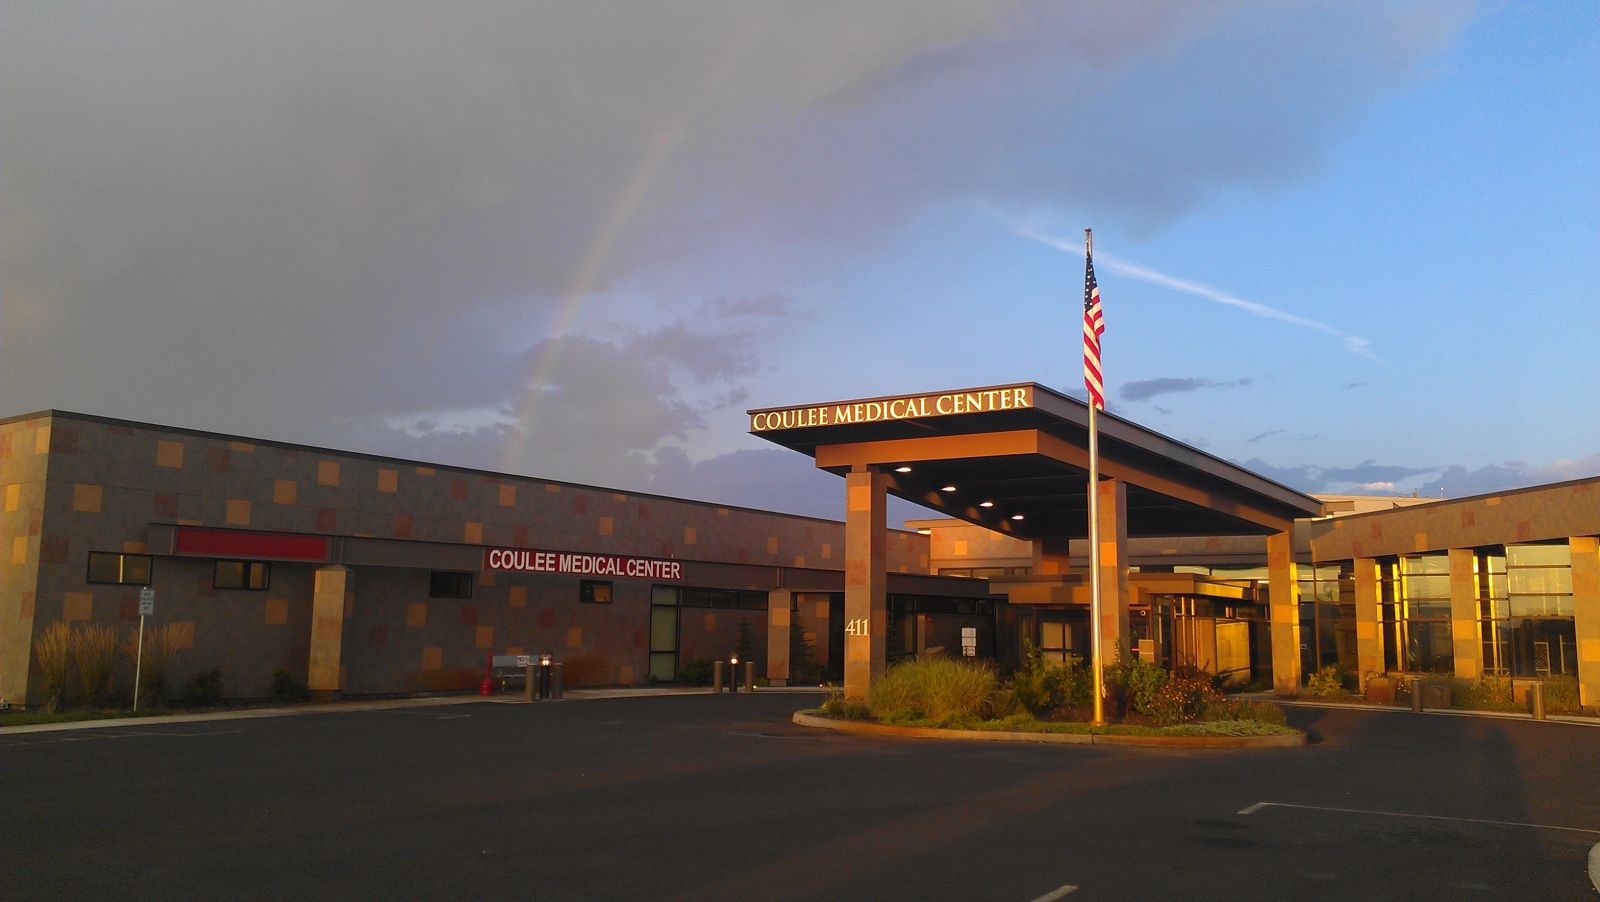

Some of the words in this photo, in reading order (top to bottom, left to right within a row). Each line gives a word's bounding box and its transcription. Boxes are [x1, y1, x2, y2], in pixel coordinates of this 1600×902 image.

[752, 407, 828, 431] COULEE
[834, 398, 931, 424] MEDICAL
[935, 388, 1030, 415] CENTER
[489, 550, 556, 572] COULEE
[558, 554, 625, 576] MEDICAL
[626, 558, 681, 579] CENTER
[845, 618, 868, 636] 411
